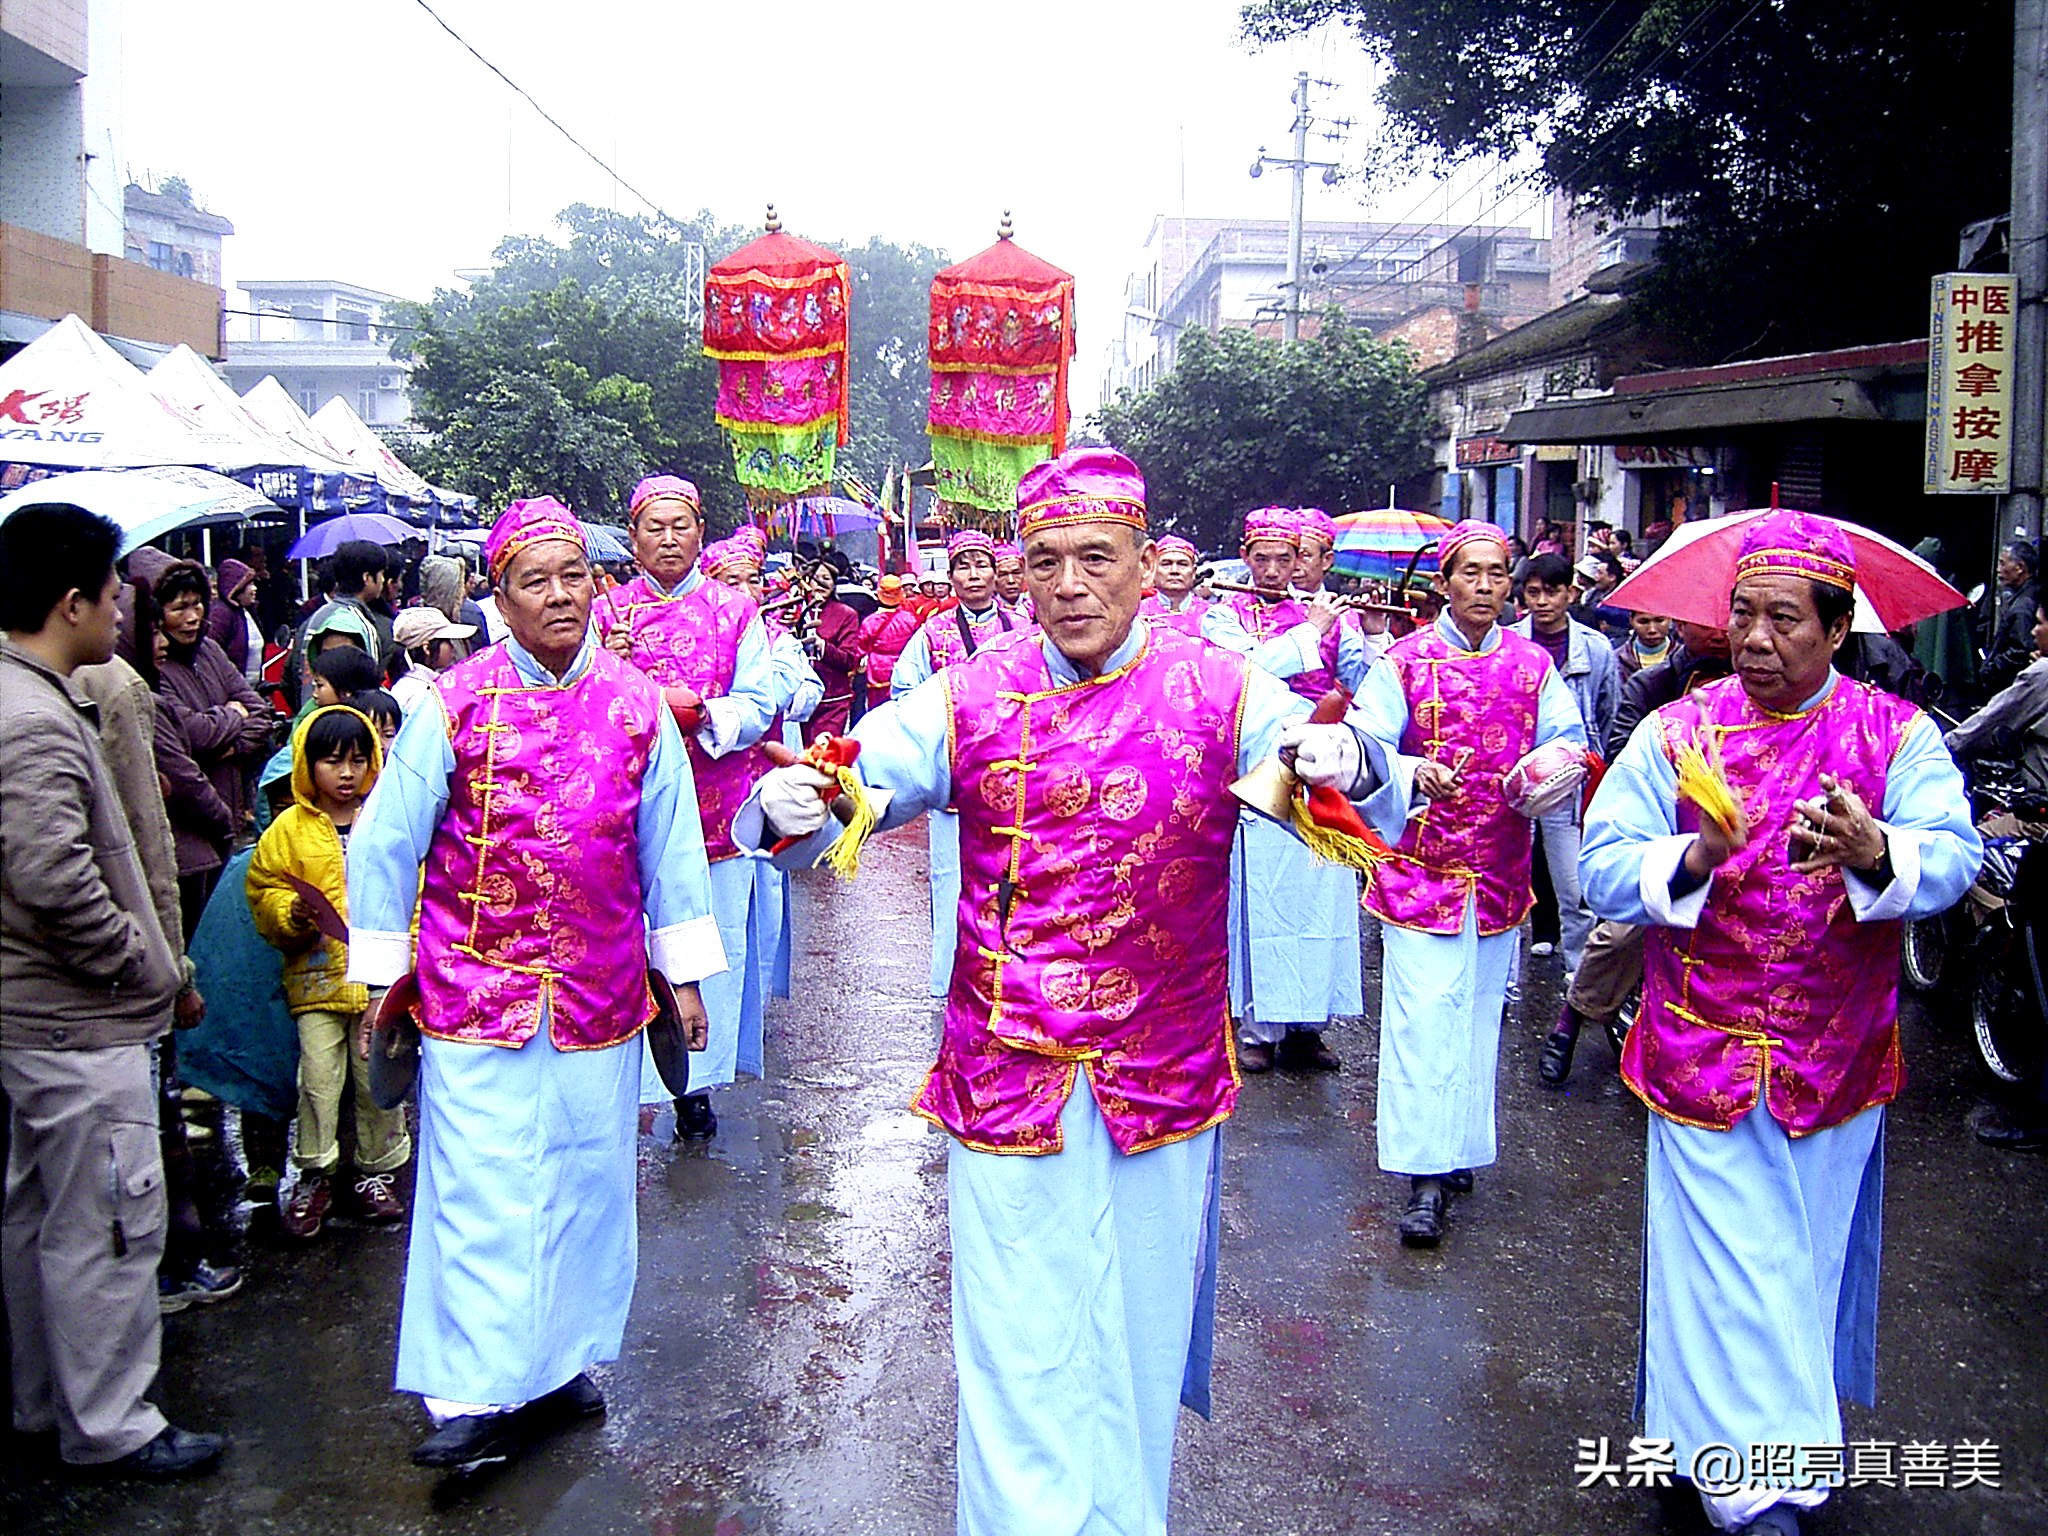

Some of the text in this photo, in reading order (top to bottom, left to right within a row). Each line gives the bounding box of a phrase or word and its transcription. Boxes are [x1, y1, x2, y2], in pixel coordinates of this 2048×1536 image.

[1951, 284, 2010, 314] 中医
[1950, 320, 2003, 482] 推拿按摩
[1928, 407, 1940, 484] MASSAGE
